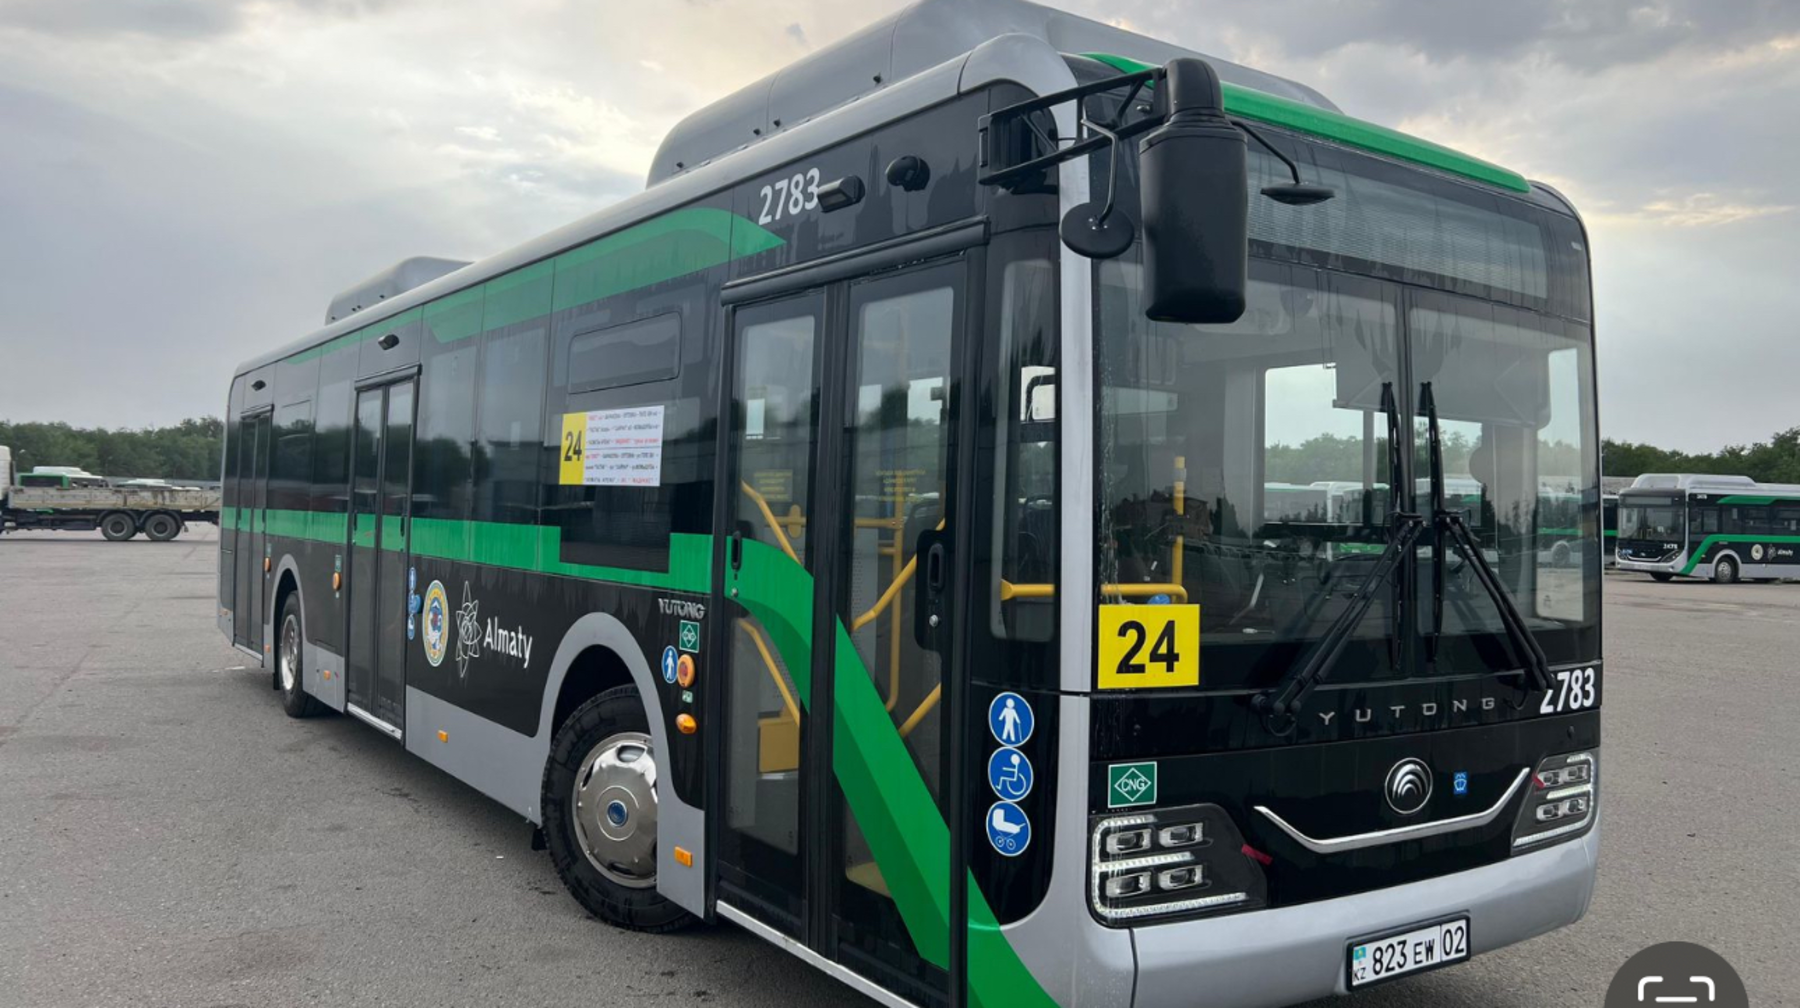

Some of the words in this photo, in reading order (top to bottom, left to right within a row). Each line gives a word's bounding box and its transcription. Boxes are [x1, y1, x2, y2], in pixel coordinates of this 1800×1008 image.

[758, 168, 820, 225] 2783
[564, 430, 582, 461] 24
[658, 598, 706, 619] YUTONG
[483, 616, 532, 668] Almaty
[1116, 619, 1180, 675] 24
[1319, 697, 1496, 726] YUTONG
[1121, 778, 1145, 792] CNG
[1372, 939, 1407, 976] 823
[1413, 938, 1435, 965] EW
[1443, 925, 1465, 957] 02
[1353, 967, 1367, 982] KZ
